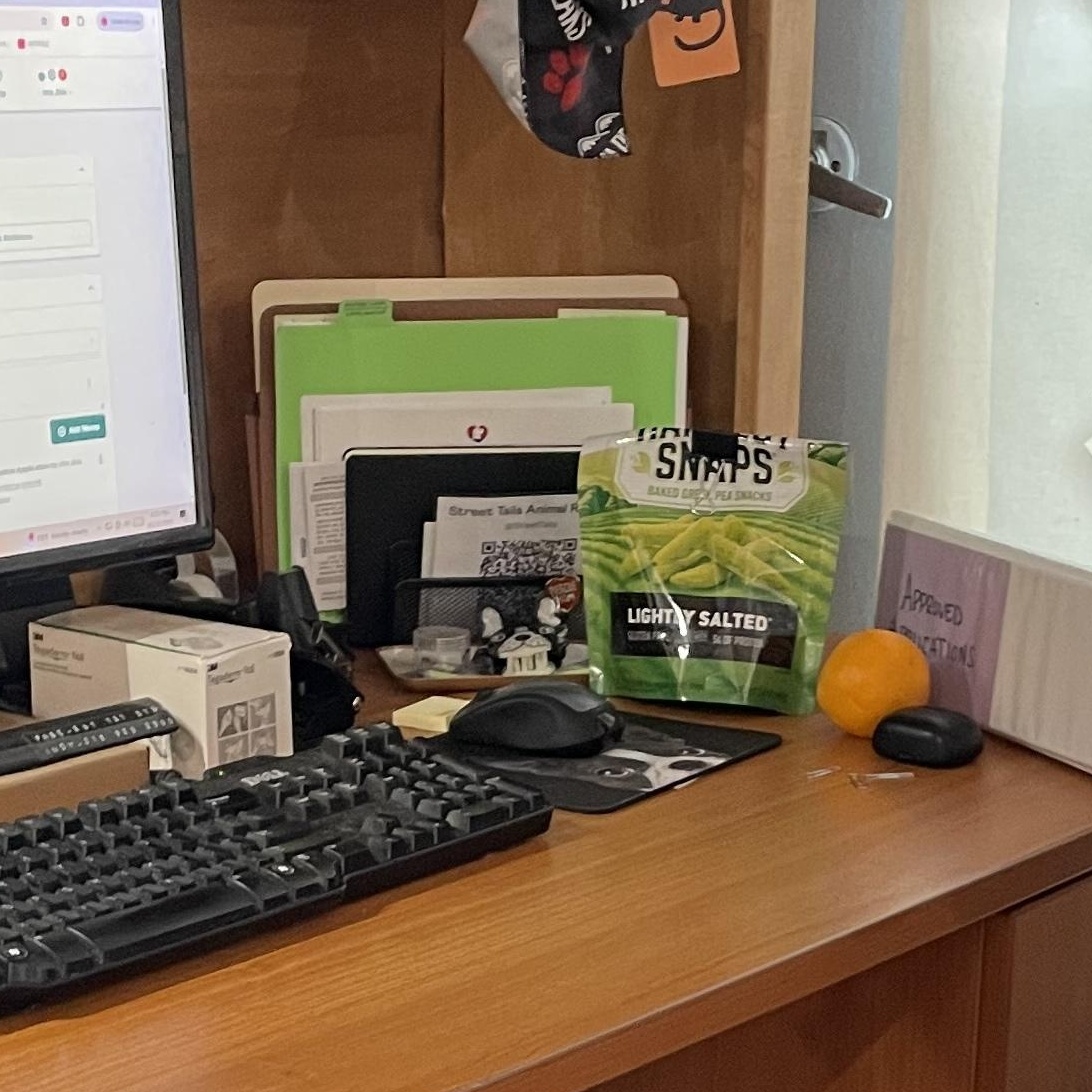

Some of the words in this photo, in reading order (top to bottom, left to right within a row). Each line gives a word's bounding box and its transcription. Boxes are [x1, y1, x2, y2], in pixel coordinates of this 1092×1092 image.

[448, 505, 494, 516] Street
[525, 503, 567, 514] Animal
[698, 611, 768, 631] SALTED
